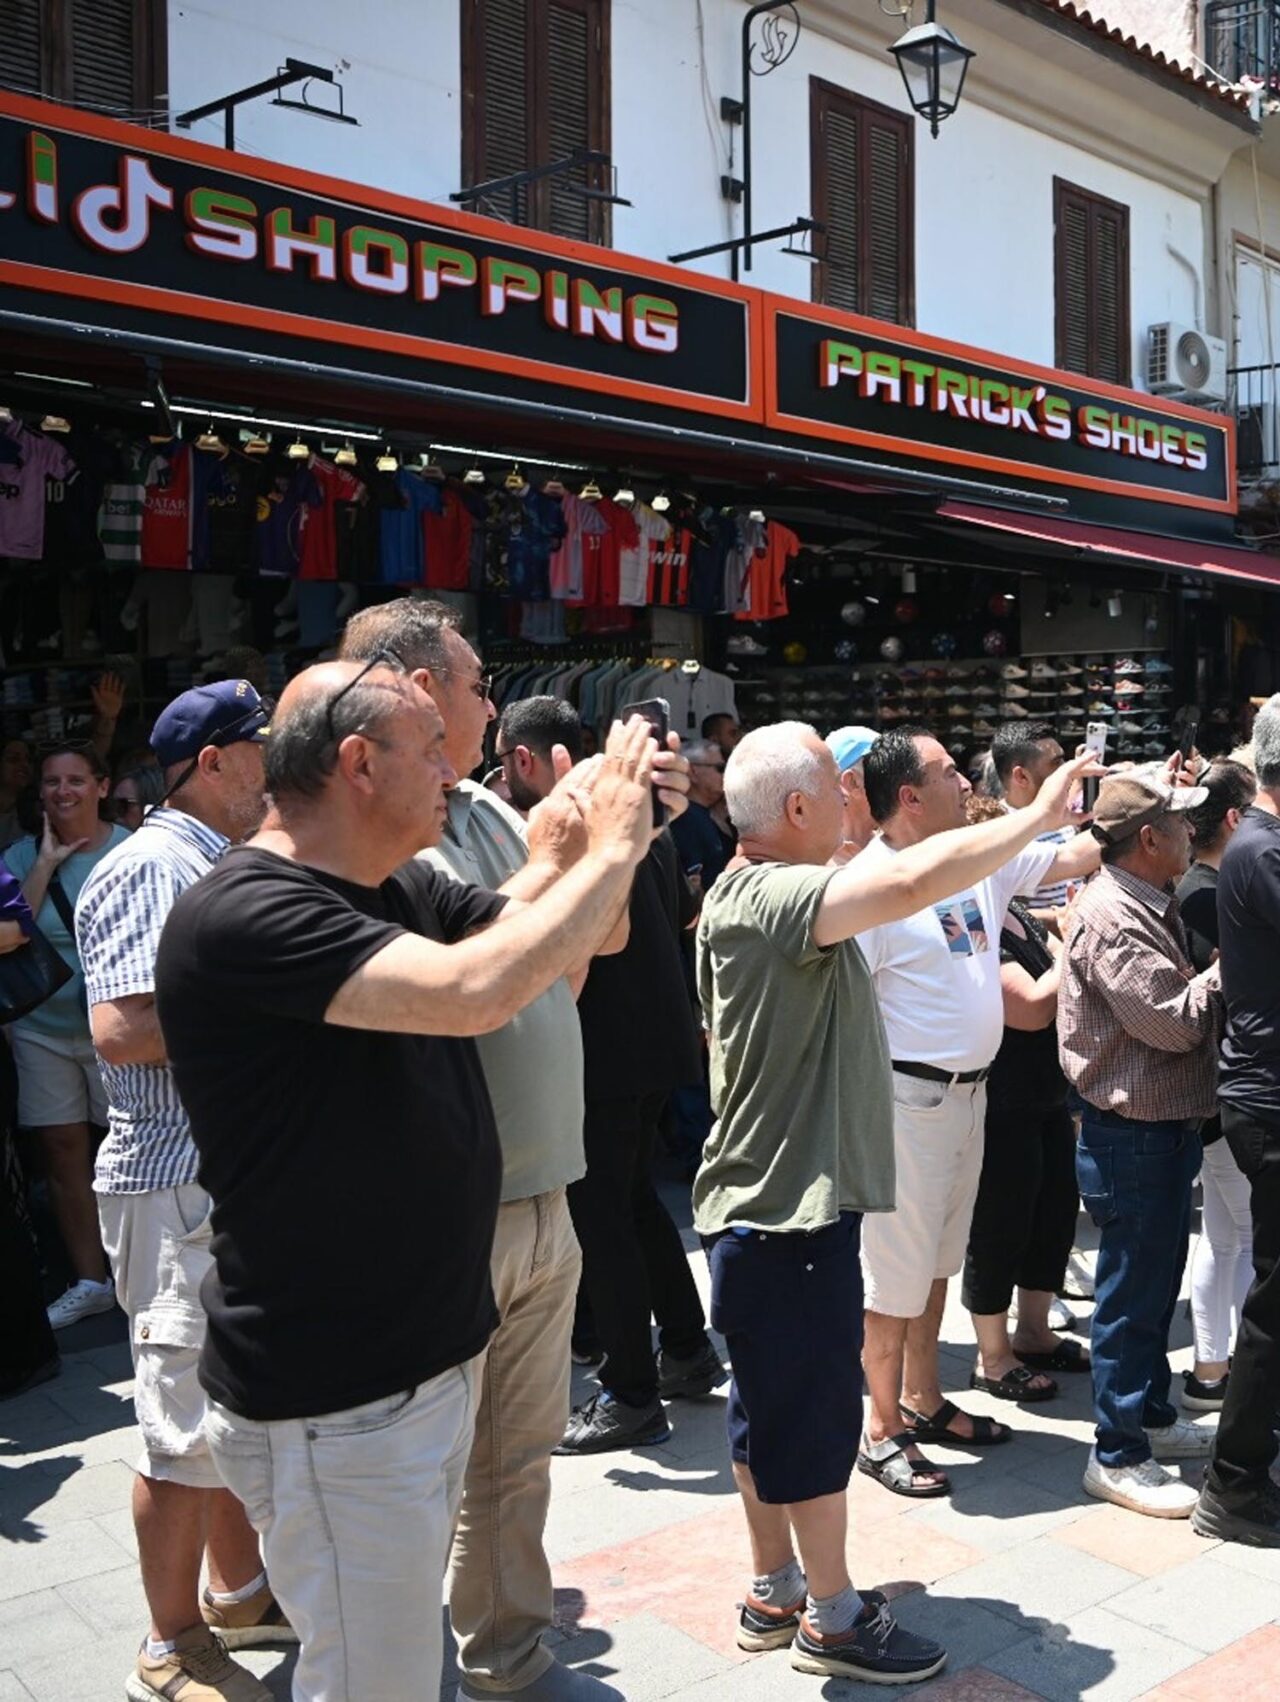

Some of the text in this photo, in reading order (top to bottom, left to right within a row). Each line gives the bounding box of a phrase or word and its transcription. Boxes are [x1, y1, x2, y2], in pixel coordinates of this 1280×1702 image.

[185, 186, 680, 355] SHOPPING
[820, 339, 1208, 472] PATRICK'S SHOES
